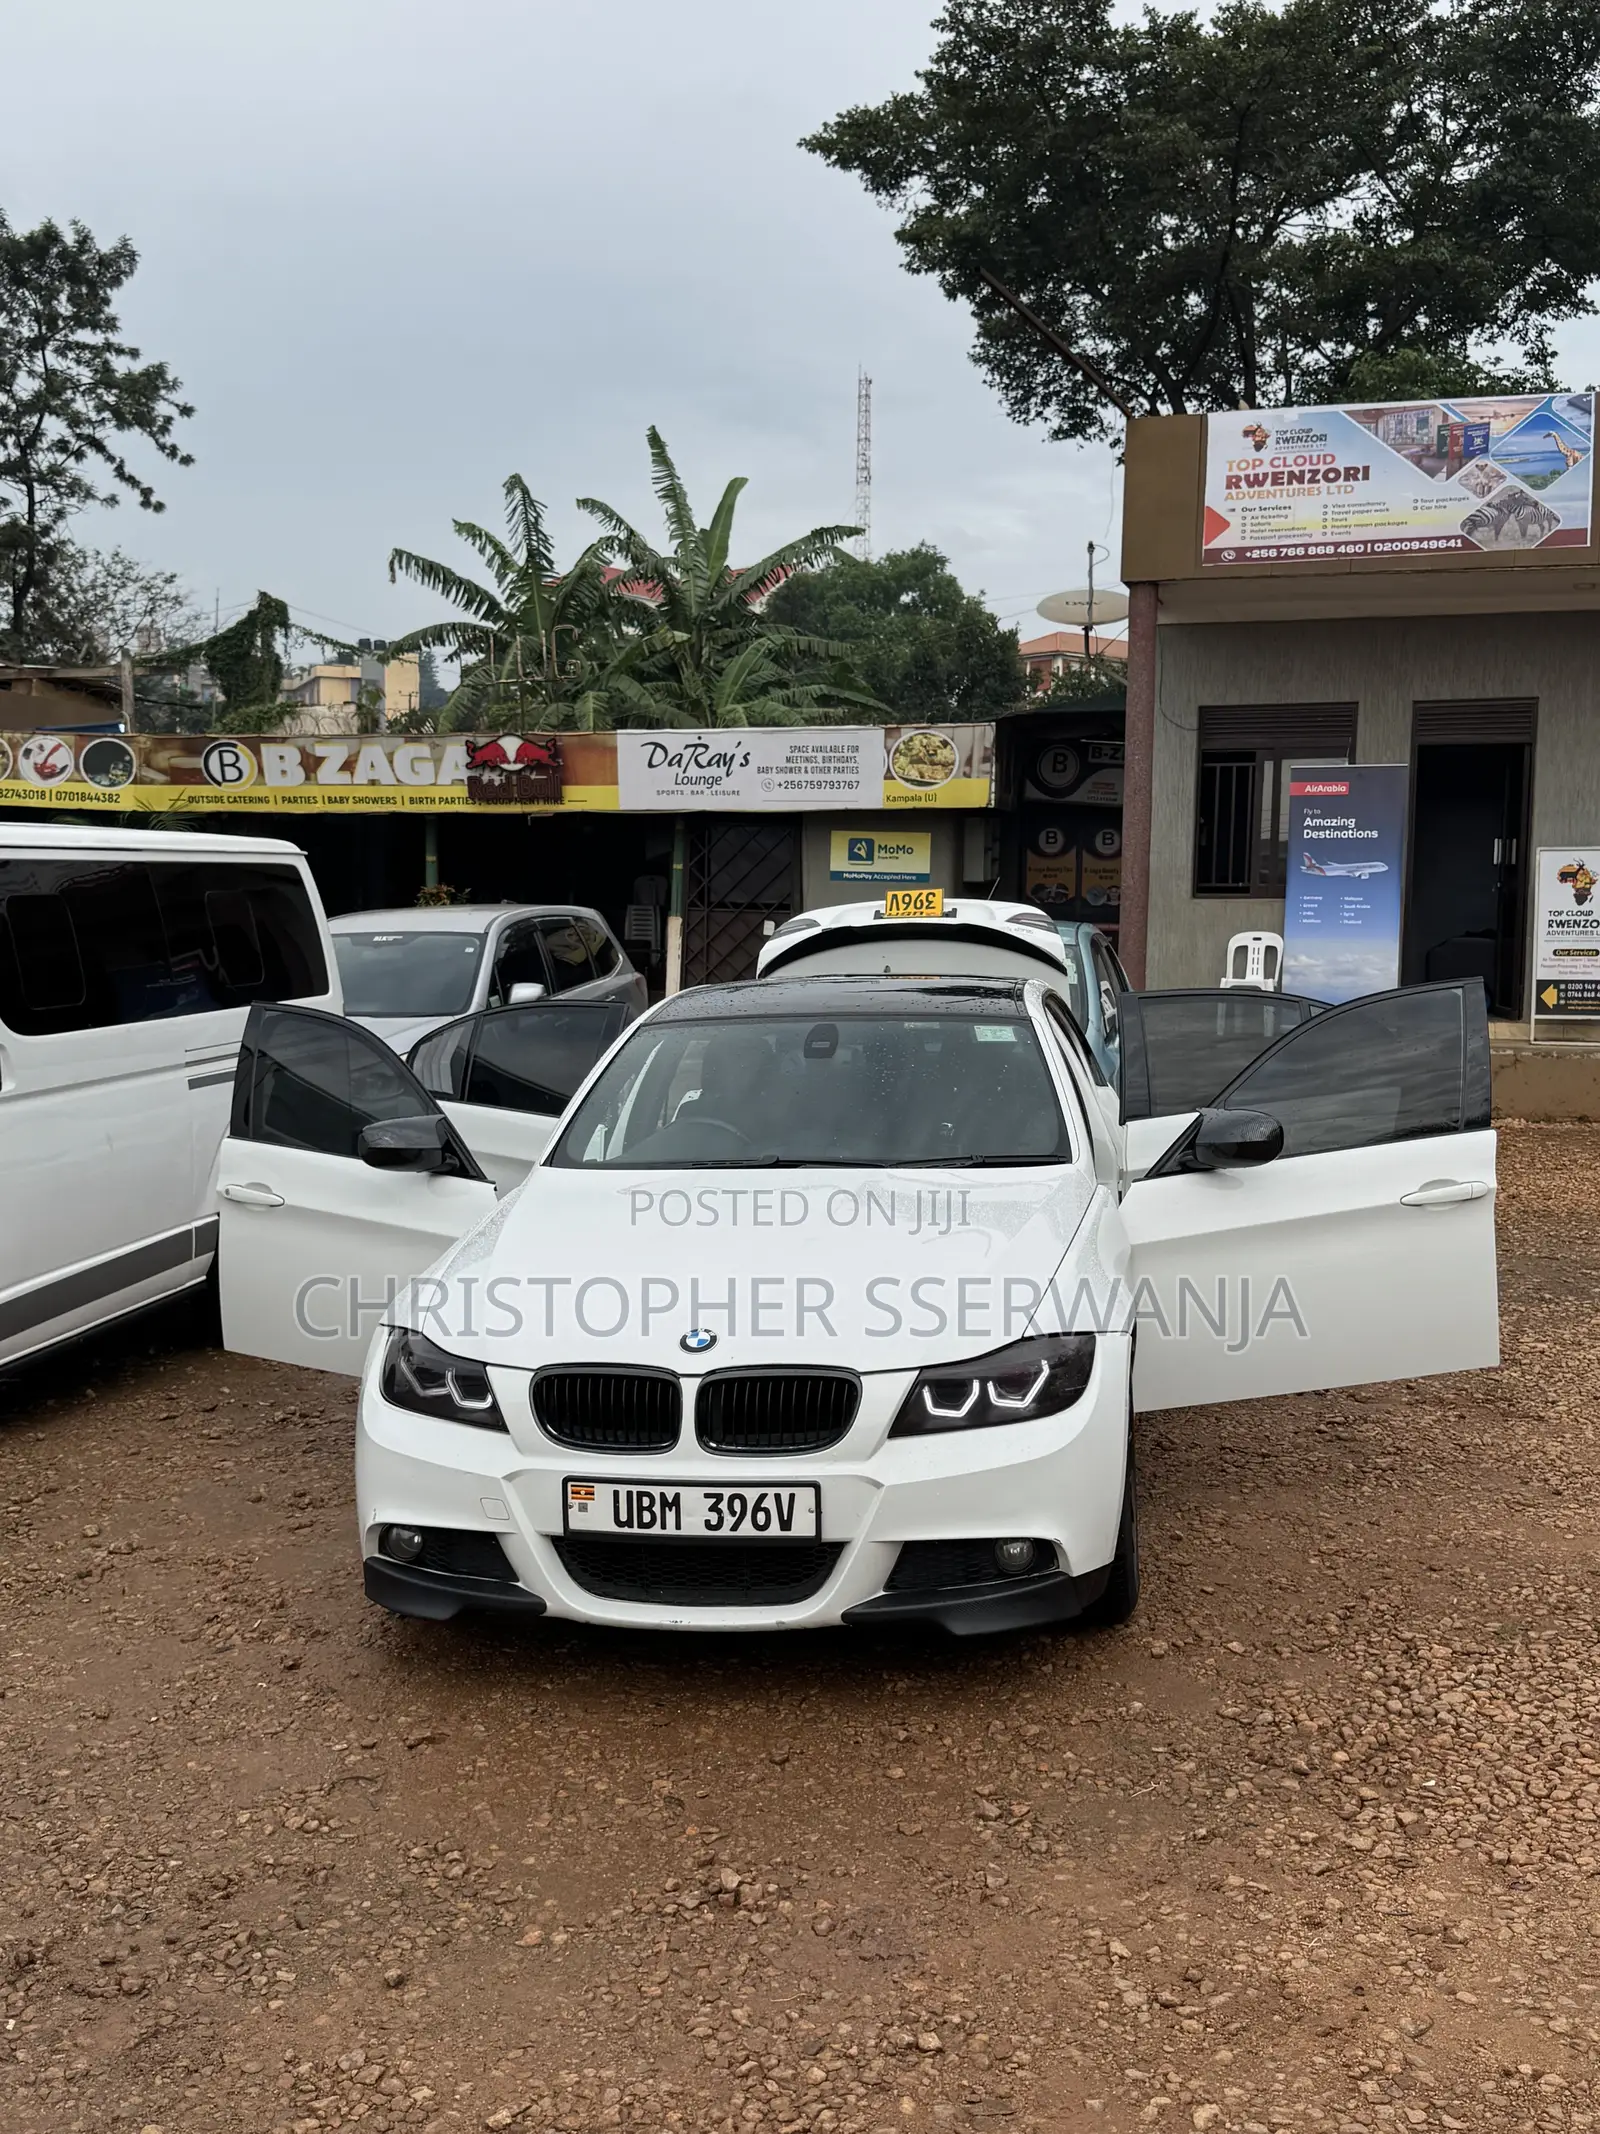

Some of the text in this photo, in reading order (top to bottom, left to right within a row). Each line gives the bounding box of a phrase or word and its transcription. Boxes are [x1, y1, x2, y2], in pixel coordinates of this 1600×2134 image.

[1276, 434, 1327, 445] RWENZORI
[1226, 453, 1336, 472] TOP CLOUD
[1225, 465, 1370, 490] RWENZORI
[1224, 484, 1355, 501] ADVENTURES LTD
[1245, 548, 1277, 558] +256
[1280, 547, 1305, 557] 766
[1307, 545, 1334, 556] 868
[1337, 544, 1364, 554] 460
[1374, 538, 1462, 552] 0200949641
[790, 745, 859, 754] SPACE AVAILABLE FOR
[640, 738, 751, 778] DaRay's
[786, 755, 820, 765] MEETINGS,
[1052, 752, 1068, 774] B
[260, 743, 306, 787] B
[757, 766, 859, 774] BABY SHOWER & OTHER PARTIES
[467, 773, 562, 799] Red Bull
[675, 773, 722, 789] Lounge
[777, 780, 860, 790] +256759793767
[1304, 784, 1346, 792] AirArabia
[55, 791, 121, 804] 0701844382
[188, 796, 226, 805] OUTSIDE
[227, 796, 270, 805] CATERING
[282, 796, 318, 805] PARTIES
[328, 796, 350, 805] BABY
[353, 796, 398, 805] SHOWERS
[409, 796, 437, 805] BIRTH
[438, 796, 476, 805] PARTIES
[886, 794, 922, 803] Kampala
[1303, 816, 1356, 828] Amazing
[1046, 830, 1058, 844] B
[1102, 832, 1114, 845] B
[1303, 829, 1379, 839] Destinations
[878, 844, 914, 855] MoMo
[612, 1489, 796, 1532] UBM 396V
